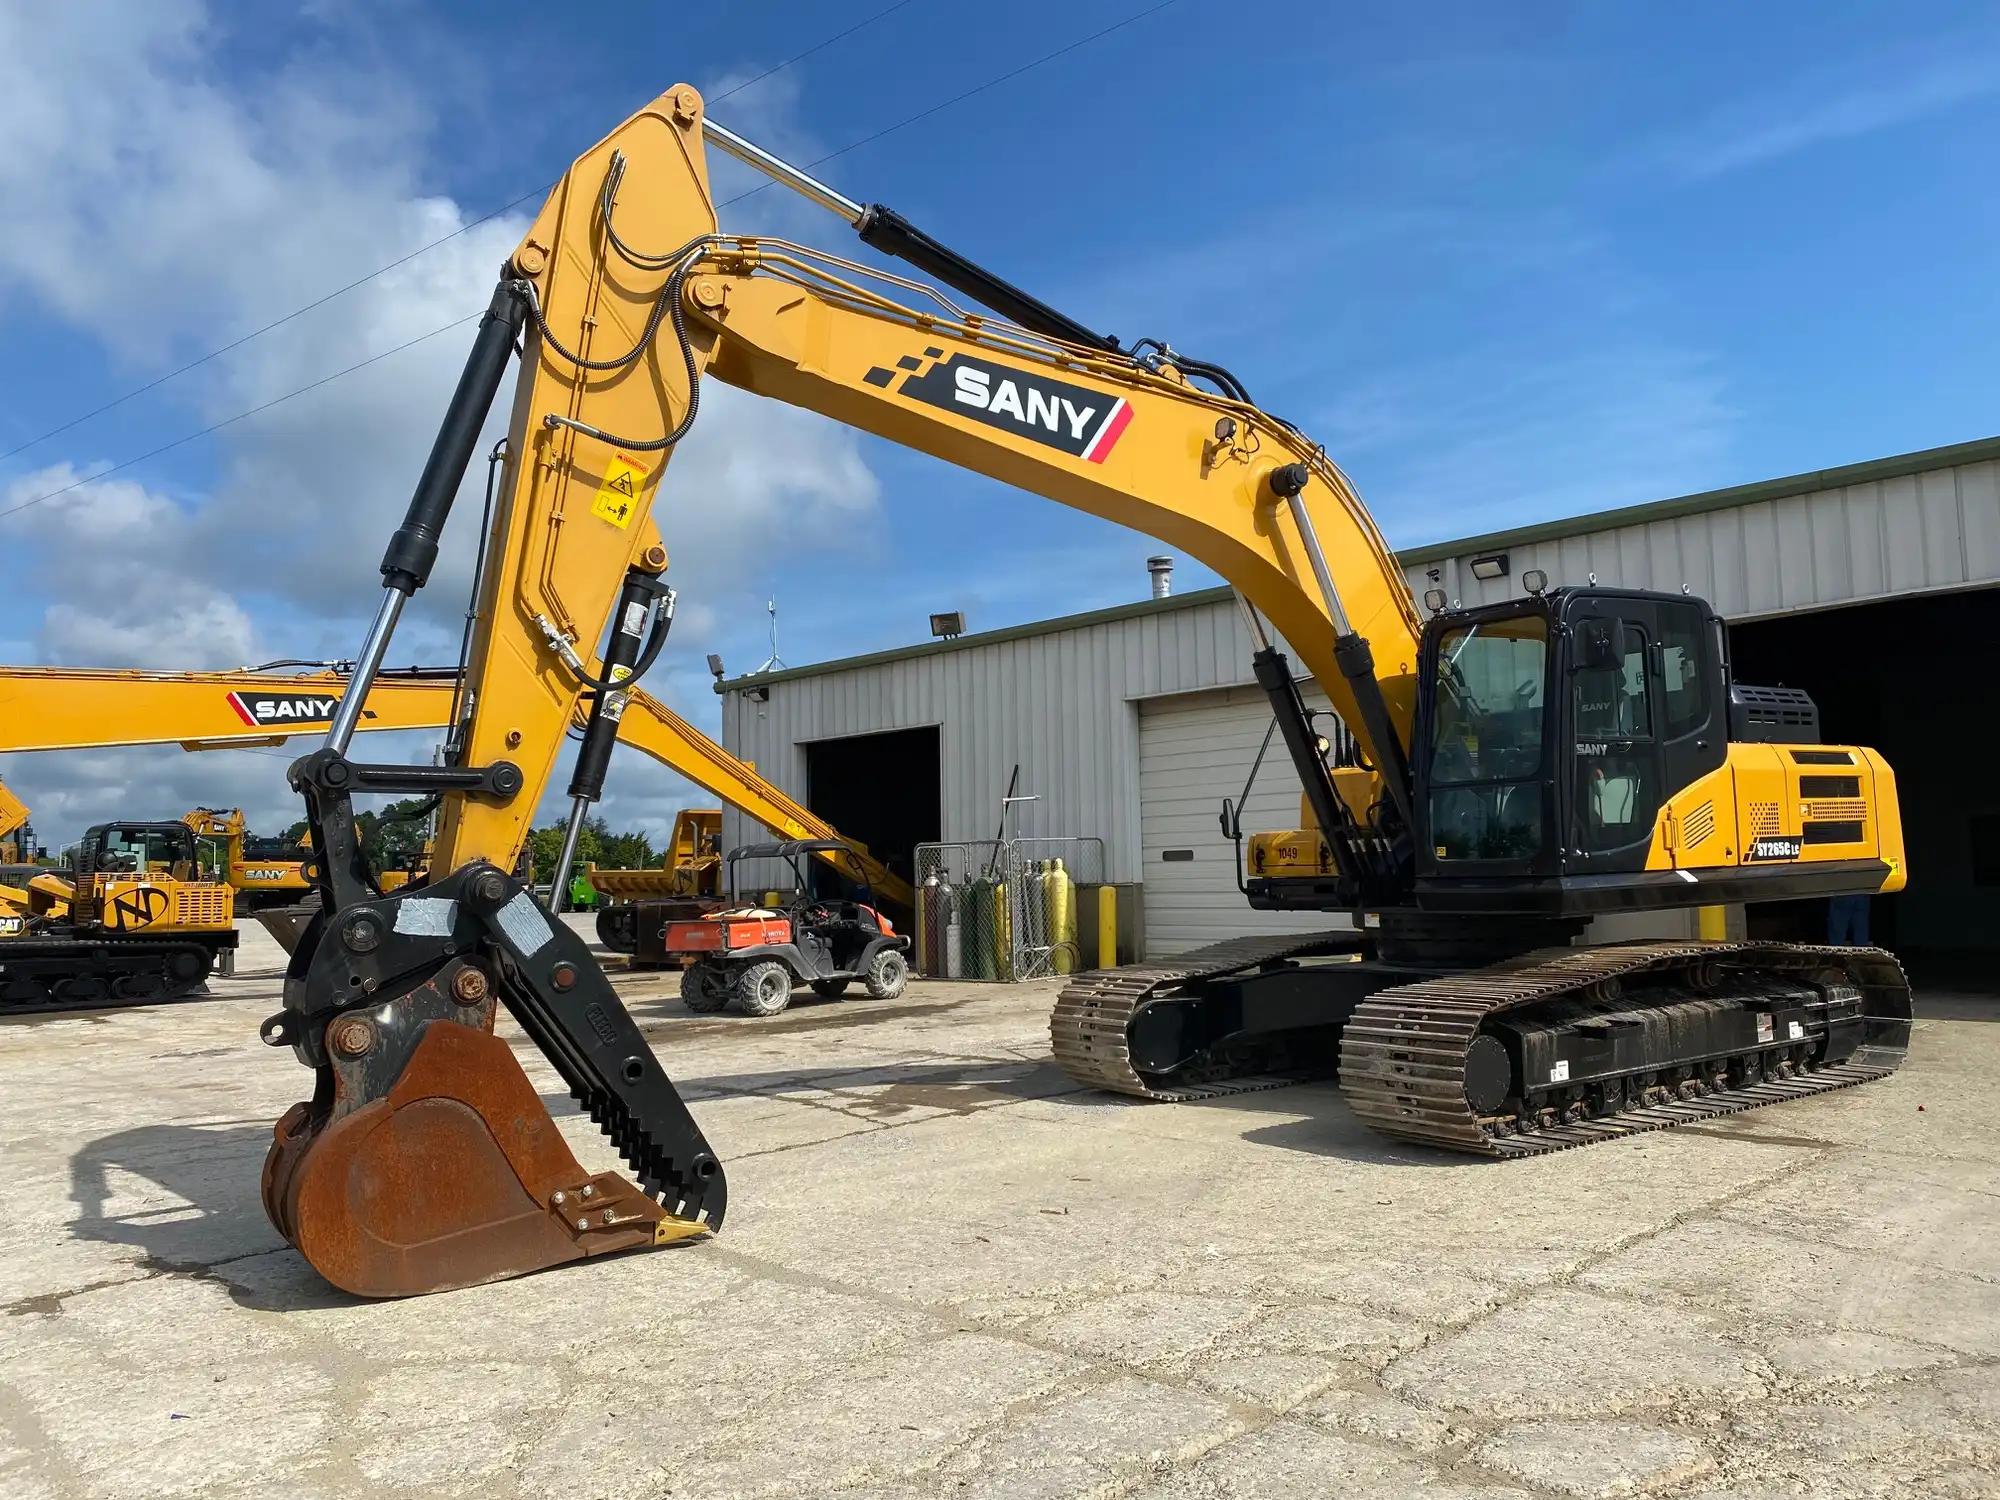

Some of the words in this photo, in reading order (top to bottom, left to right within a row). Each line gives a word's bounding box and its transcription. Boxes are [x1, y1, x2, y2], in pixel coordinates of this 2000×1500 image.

[954, 365, 1097, 440] SANY
[255, 699, 334, 719] SANY
[1581, 702, 1610, 712] SANY
[1576, 743, 1608, 756] SANY
[1278, 847, 1298, 859] 1049
[1757, 841, 1791, 857] SY265C
[245, 870, 287, 880] SANY
